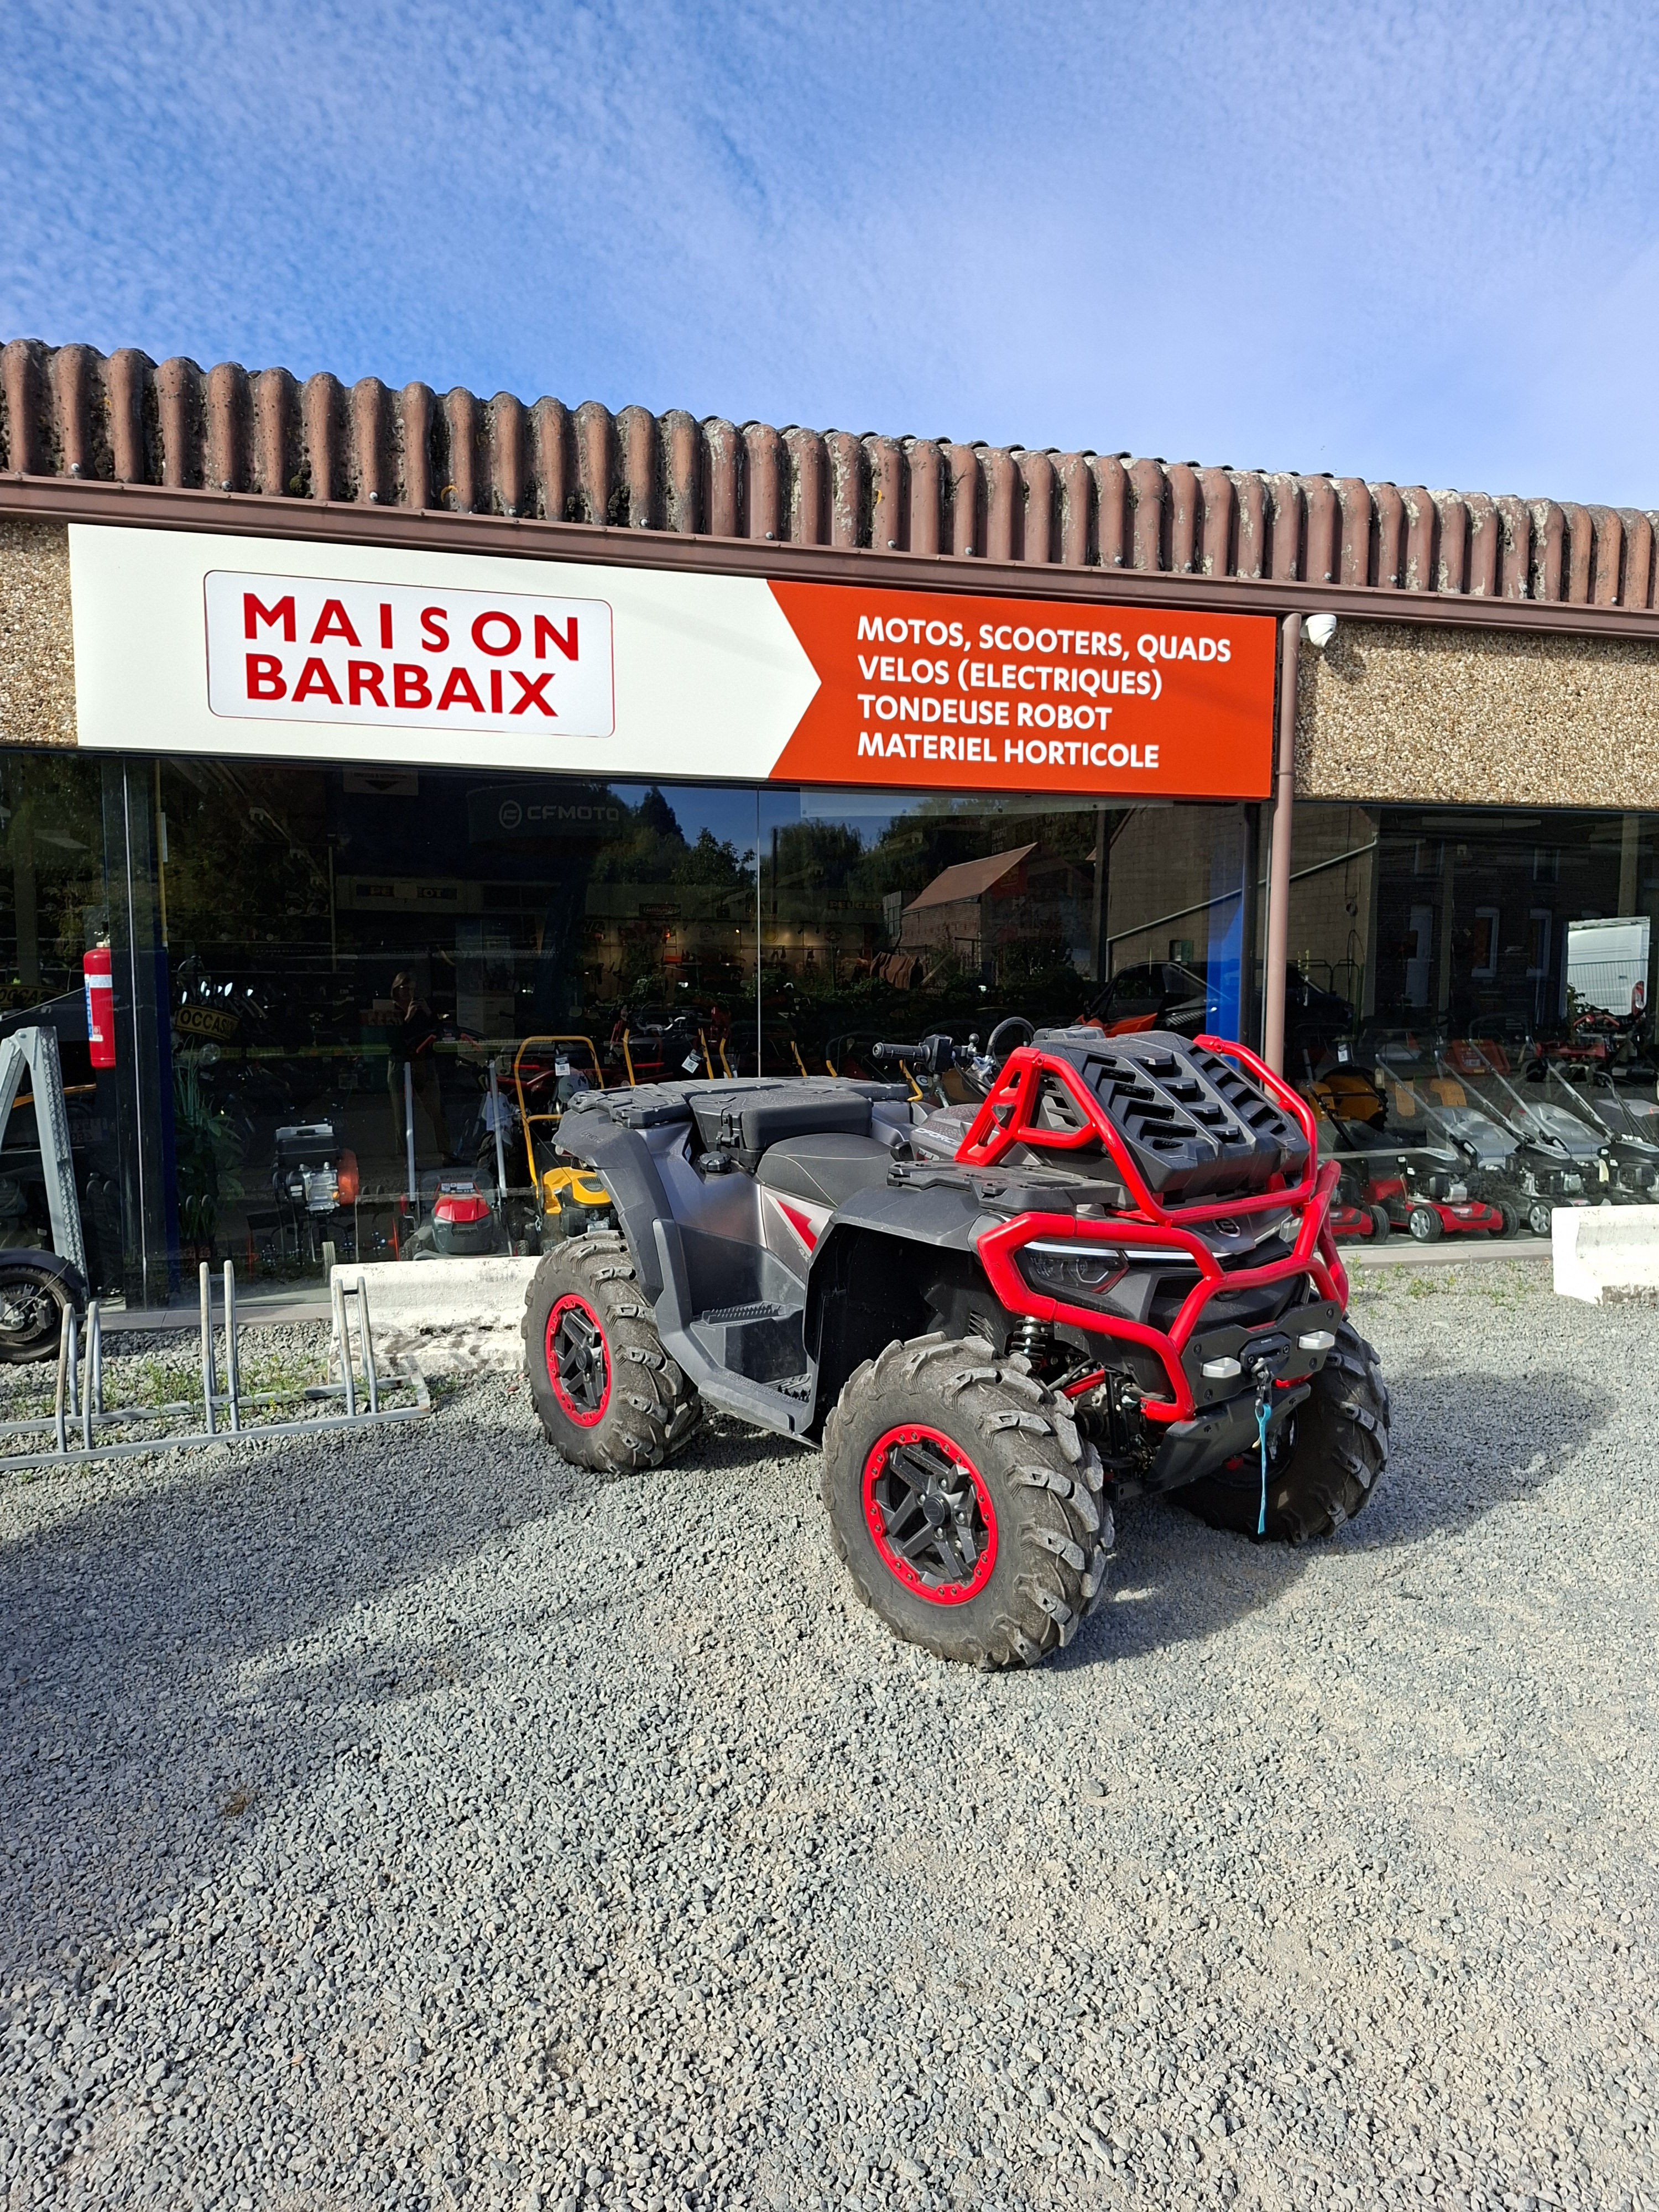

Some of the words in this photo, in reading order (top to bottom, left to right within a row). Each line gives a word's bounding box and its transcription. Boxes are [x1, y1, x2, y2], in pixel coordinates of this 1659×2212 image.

[243, 593, 578, 661] MAISON
[857, 615, 971, 652] MOTOS,
[979, 624, 1130, 661] SCOOTERS,
[1137, 634, 1231, 663] QUADS
[245, 653, 557, 717] BARBAIX
[857, 655, 950, 685] VELOS
[958, 659, 1162, 700] (ELECTRIQUES)
[857, 693, 1009, 726] TONDEUSE
[1017, 702, 1113, 731] ROBOT
[857, 732, 998, 762] MATERIEL
[1004, 739, 1159, 768] HORTICOLE
[526, 805, 620, 822] CFMOTO
[828, 900, 883, 910] PEUGEO
